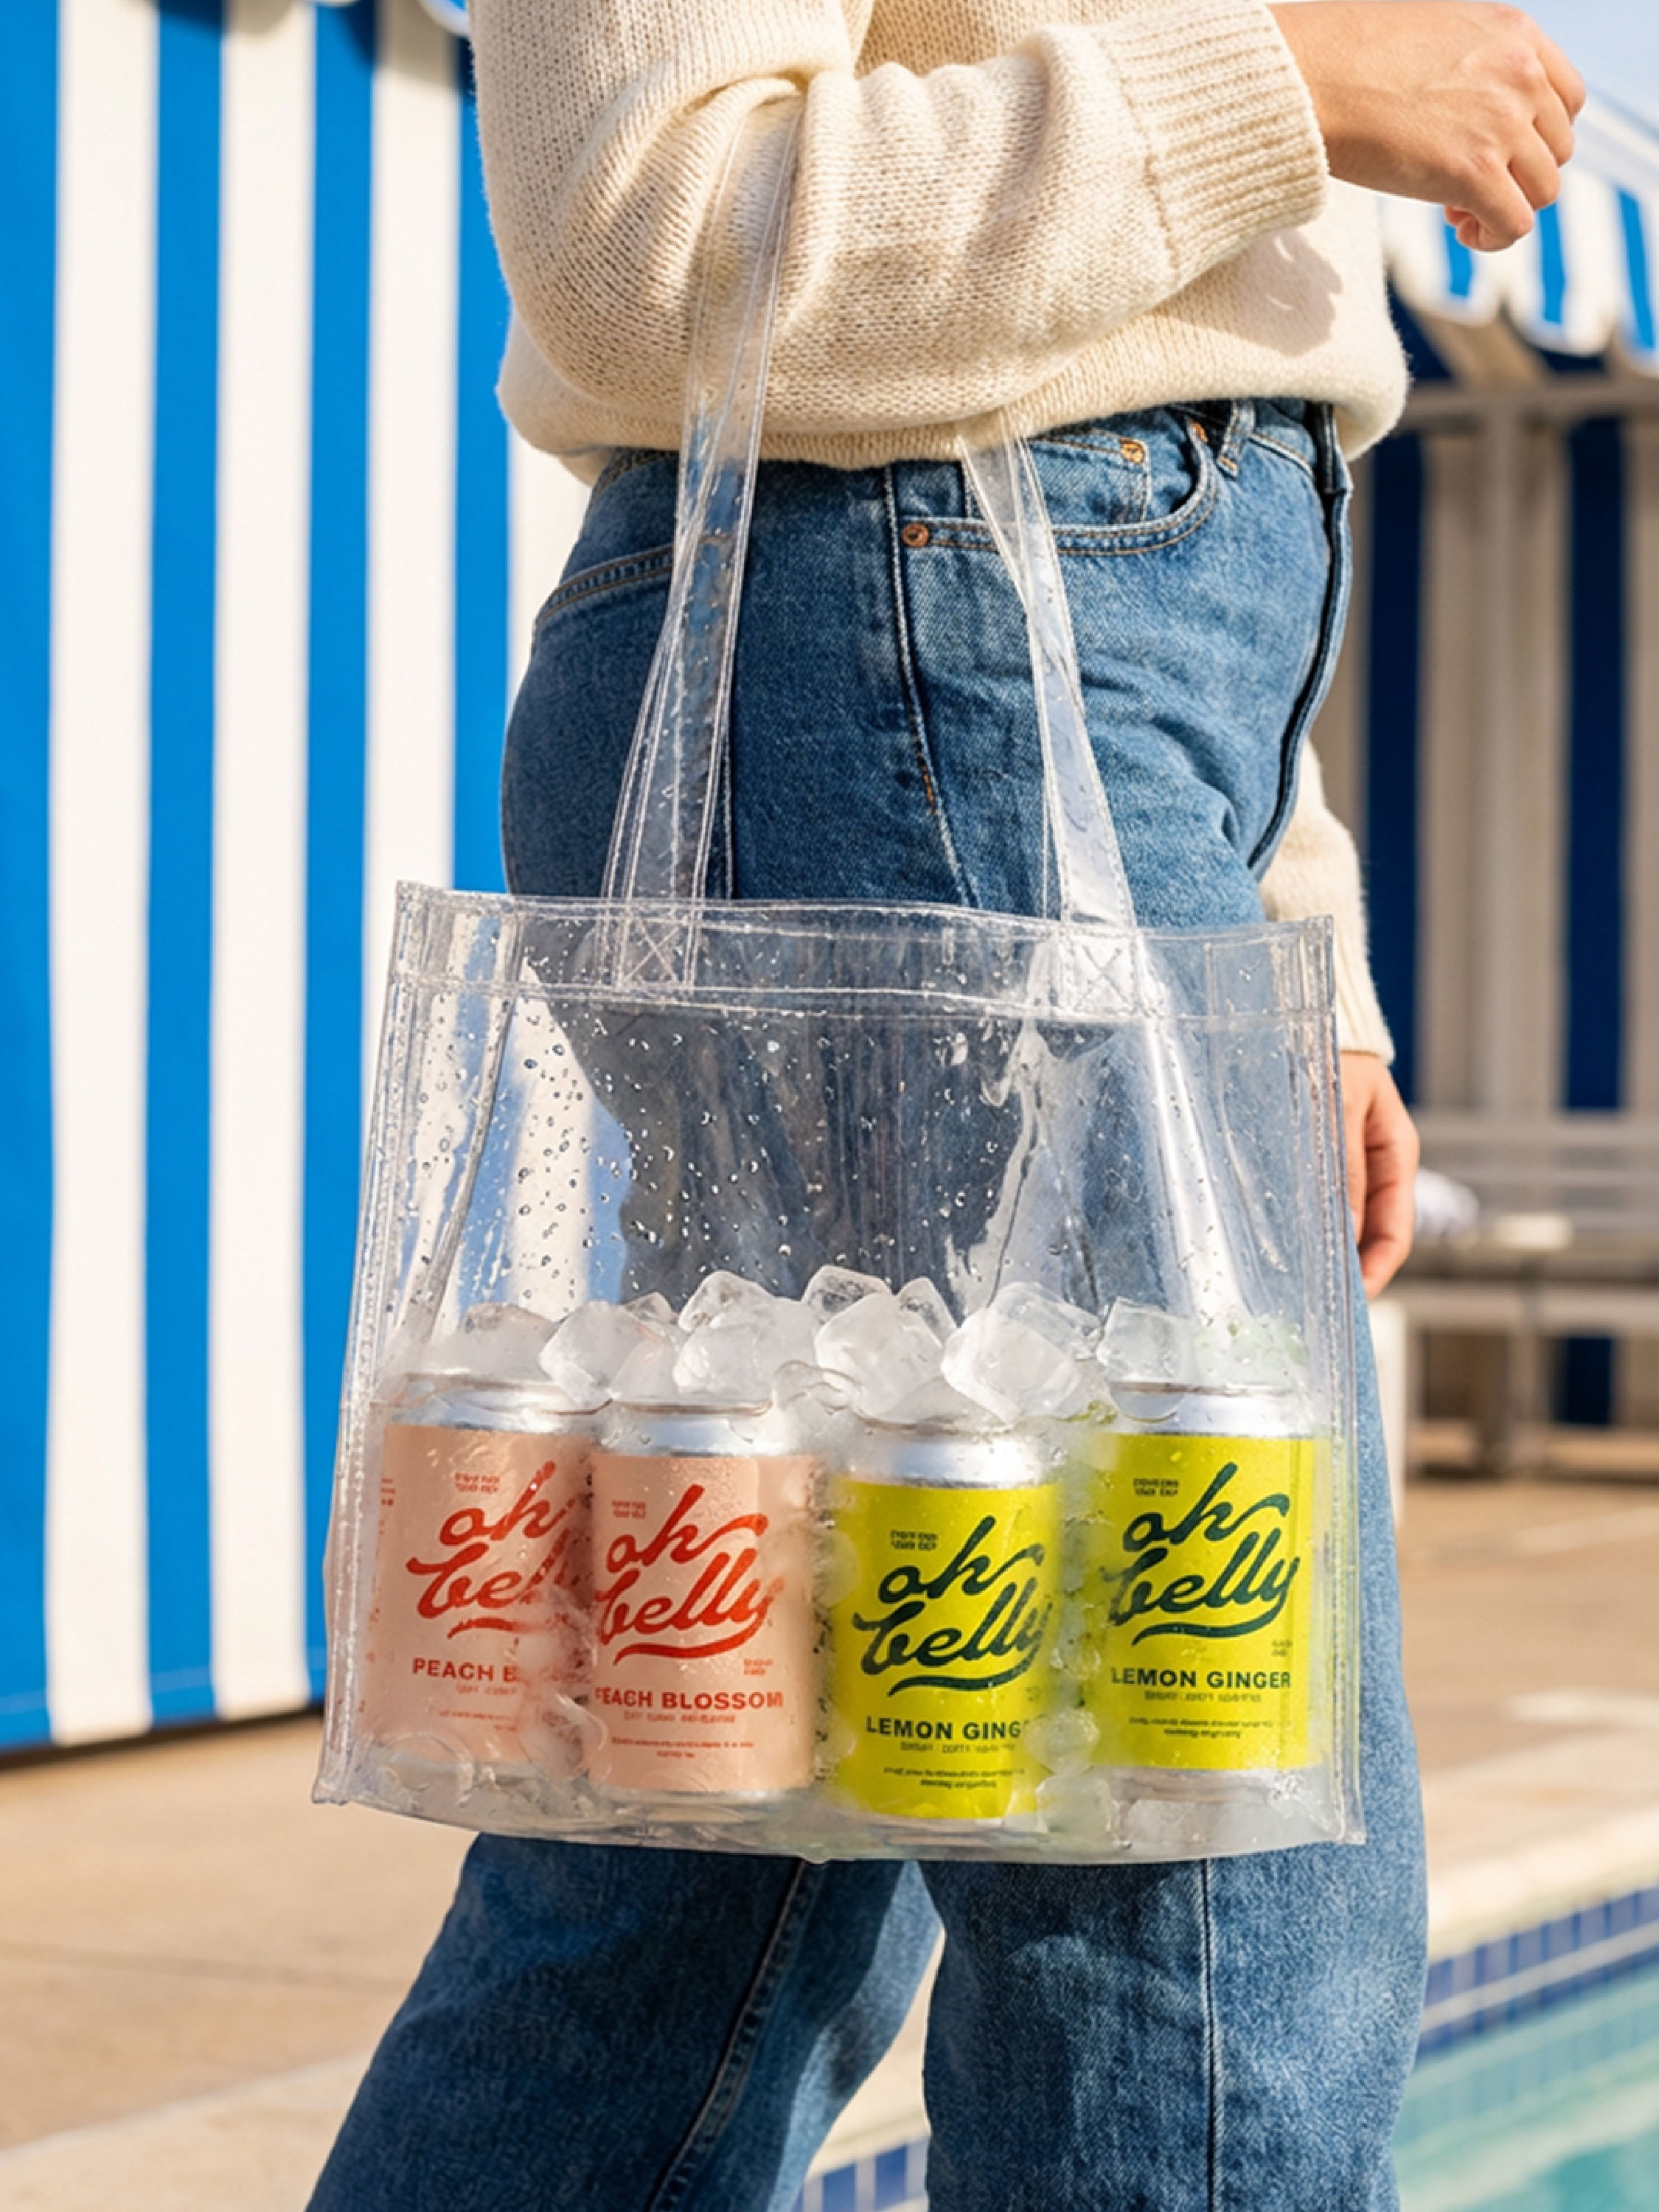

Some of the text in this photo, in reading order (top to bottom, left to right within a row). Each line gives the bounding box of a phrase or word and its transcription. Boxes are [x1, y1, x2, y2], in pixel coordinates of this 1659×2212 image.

[439, 1460, 577, 1545] oh
[606, 1484, 768, 1573] oh
[1123, 1462, 1290, 1552] oh
[877, 1514, 1044, 1604] oh
[1099, 1527, 1300, 1646] belly
[594, 1547, 785, 1666] belly
[852, 1576, 1053, 1697] belly
[411, 1658, 495, 1682] PEACH
[661, 1691, 783, 1711] BLOSSOM
[1111, 1666, 1291, 1690] LEMON GINGER
[866, 1715, 1030, 1740] LEMON GING
